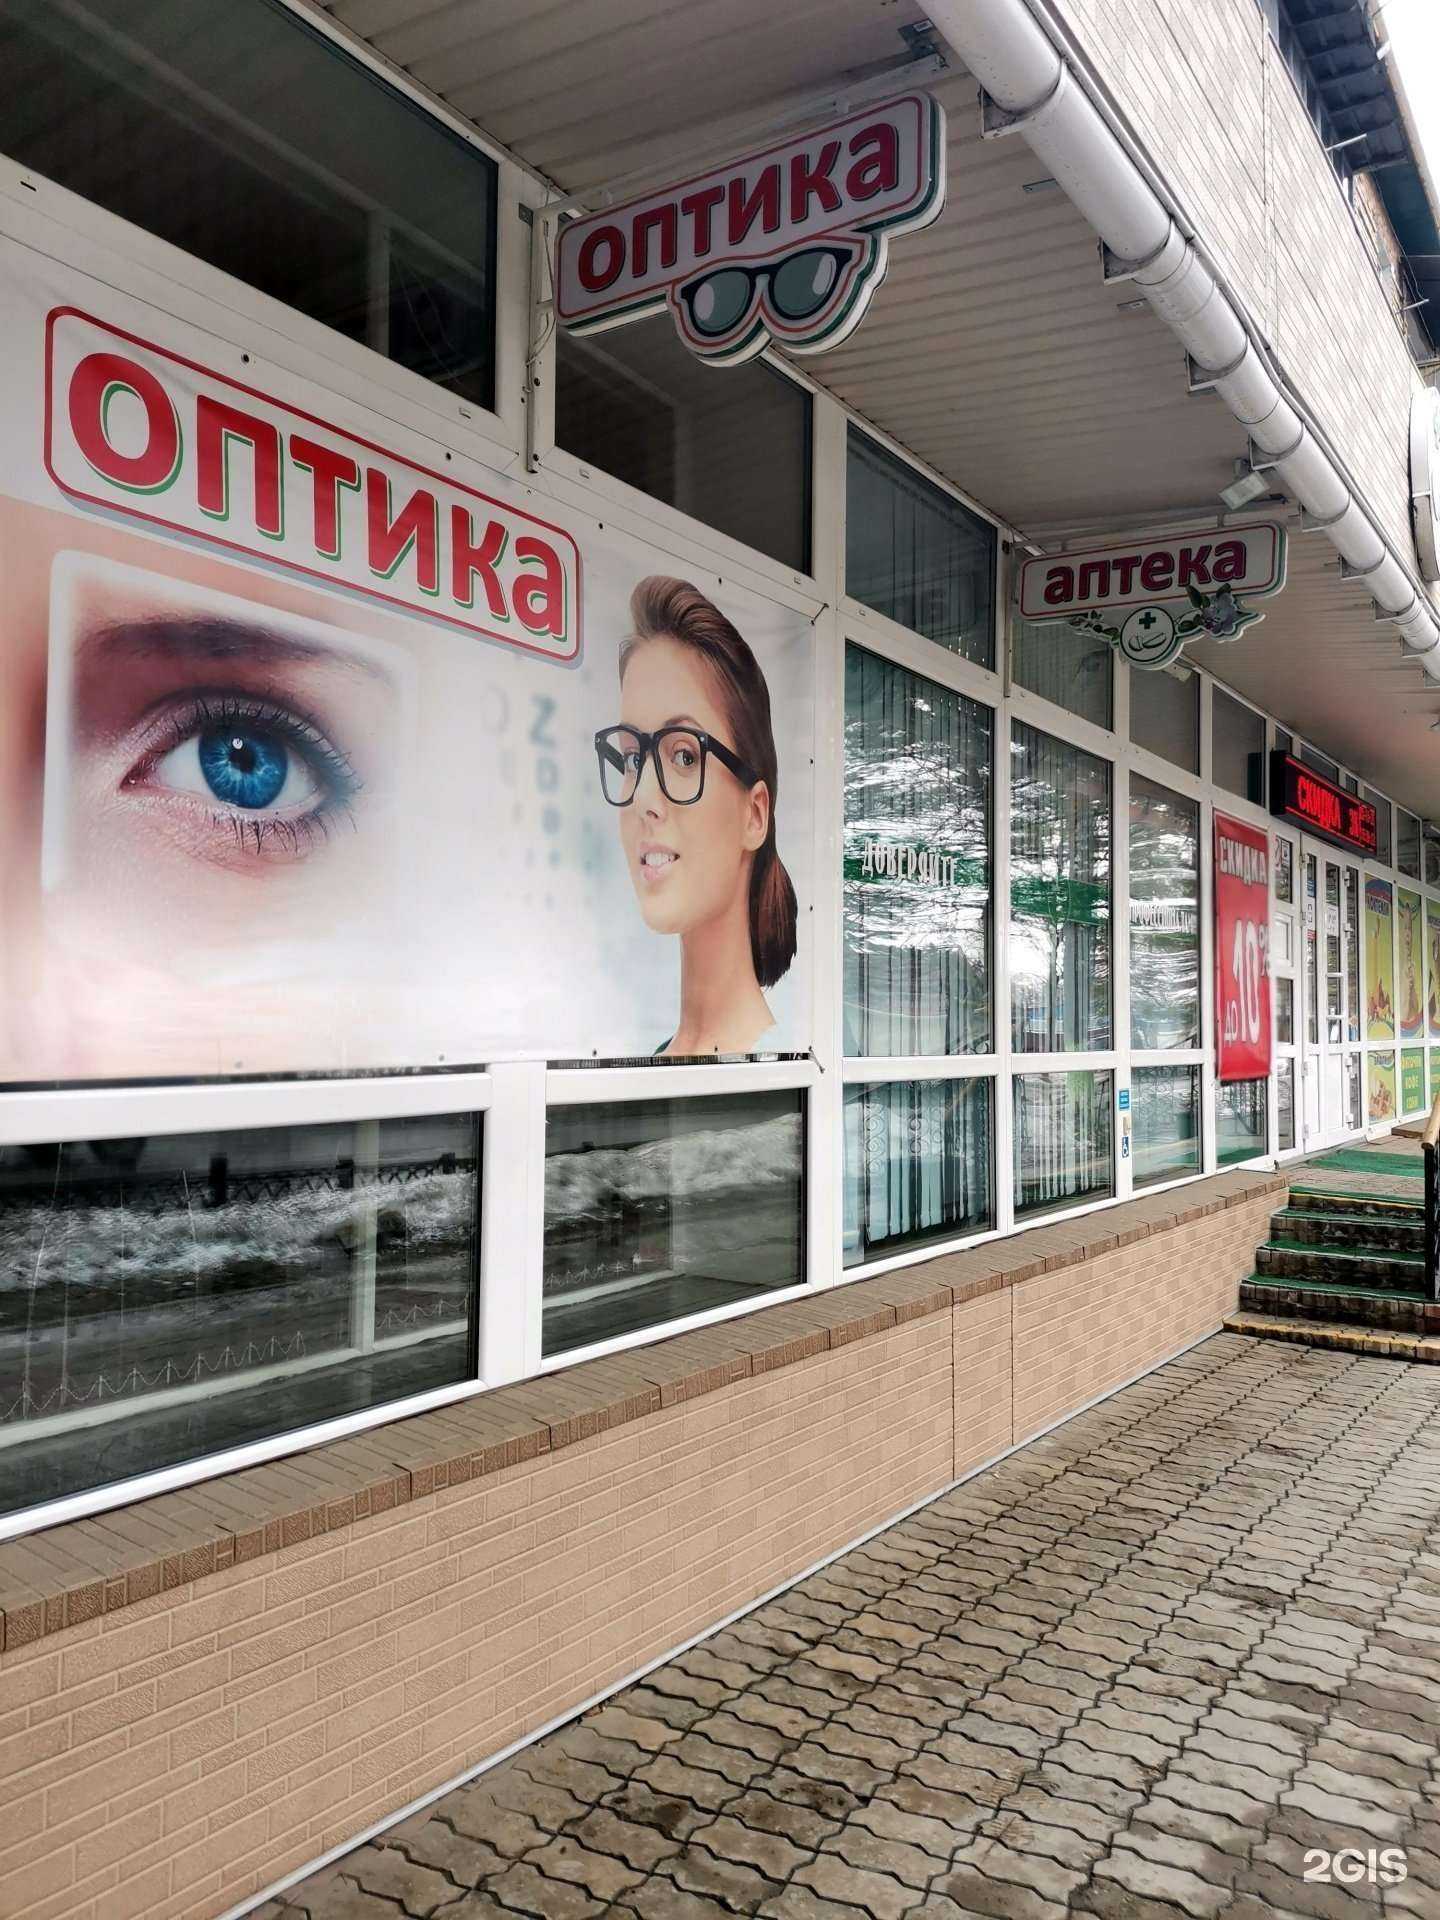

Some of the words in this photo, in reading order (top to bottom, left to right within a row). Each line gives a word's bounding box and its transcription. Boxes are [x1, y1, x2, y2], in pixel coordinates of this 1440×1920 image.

[577, 122, 899, 293] оптика
[1044, 540, 1247, 605] аптека
[1298, 775, 1341, 830] СКИДКА
[1219, 836, 1268, 886] СКИДКА
